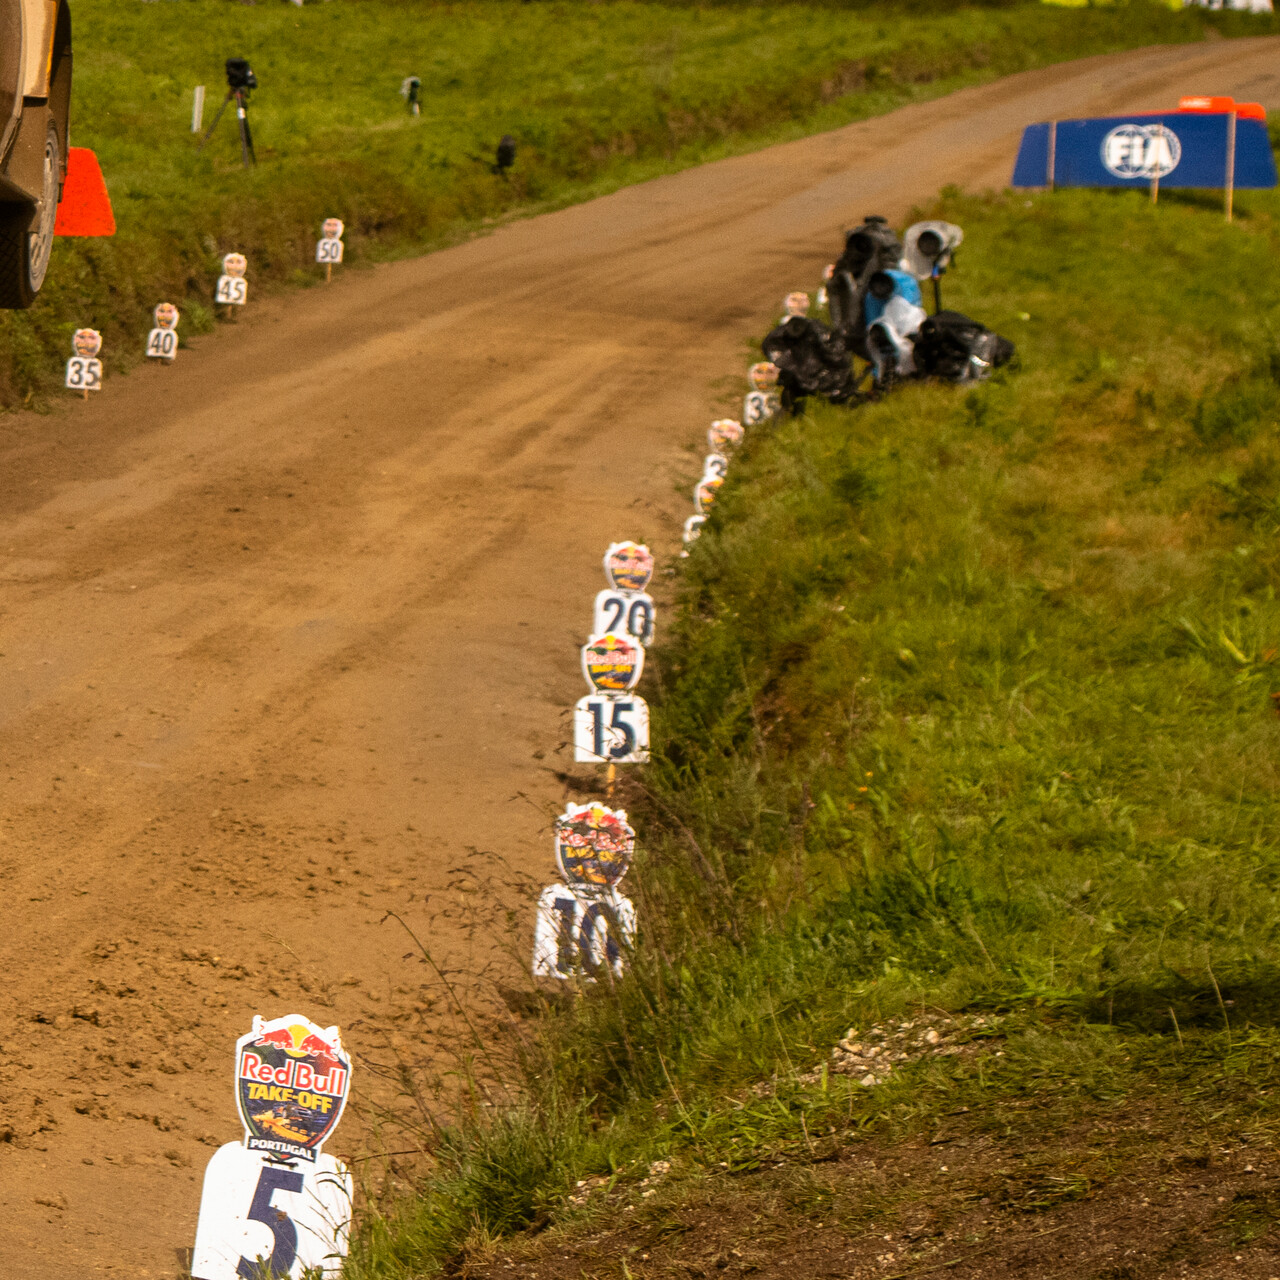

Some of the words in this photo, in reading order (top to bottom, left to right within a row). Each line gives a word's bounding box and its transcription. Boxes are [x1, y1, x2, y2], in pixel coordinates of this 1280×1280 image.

[1107, 134, 1174, 167] FIA
[320, 241, 339, 260] 50
[219, 280, 244, 301] 45
[151, 331, 174, 354] 40
[70, 360, 100, 387] 35
[602, 597, 653, 643] 20
[588, 702, 637, 759] 15
[554, 897, 621, 976] 10
[242, 1052, 293, 1086] Red
[294, 1063, 347, 1096] Bull
[247, 1082, 333, 1114] TAKE-OFF
[249, 1137, 317, 1161] PORTUGAL
[235, 1165, 305, 1280] 5
